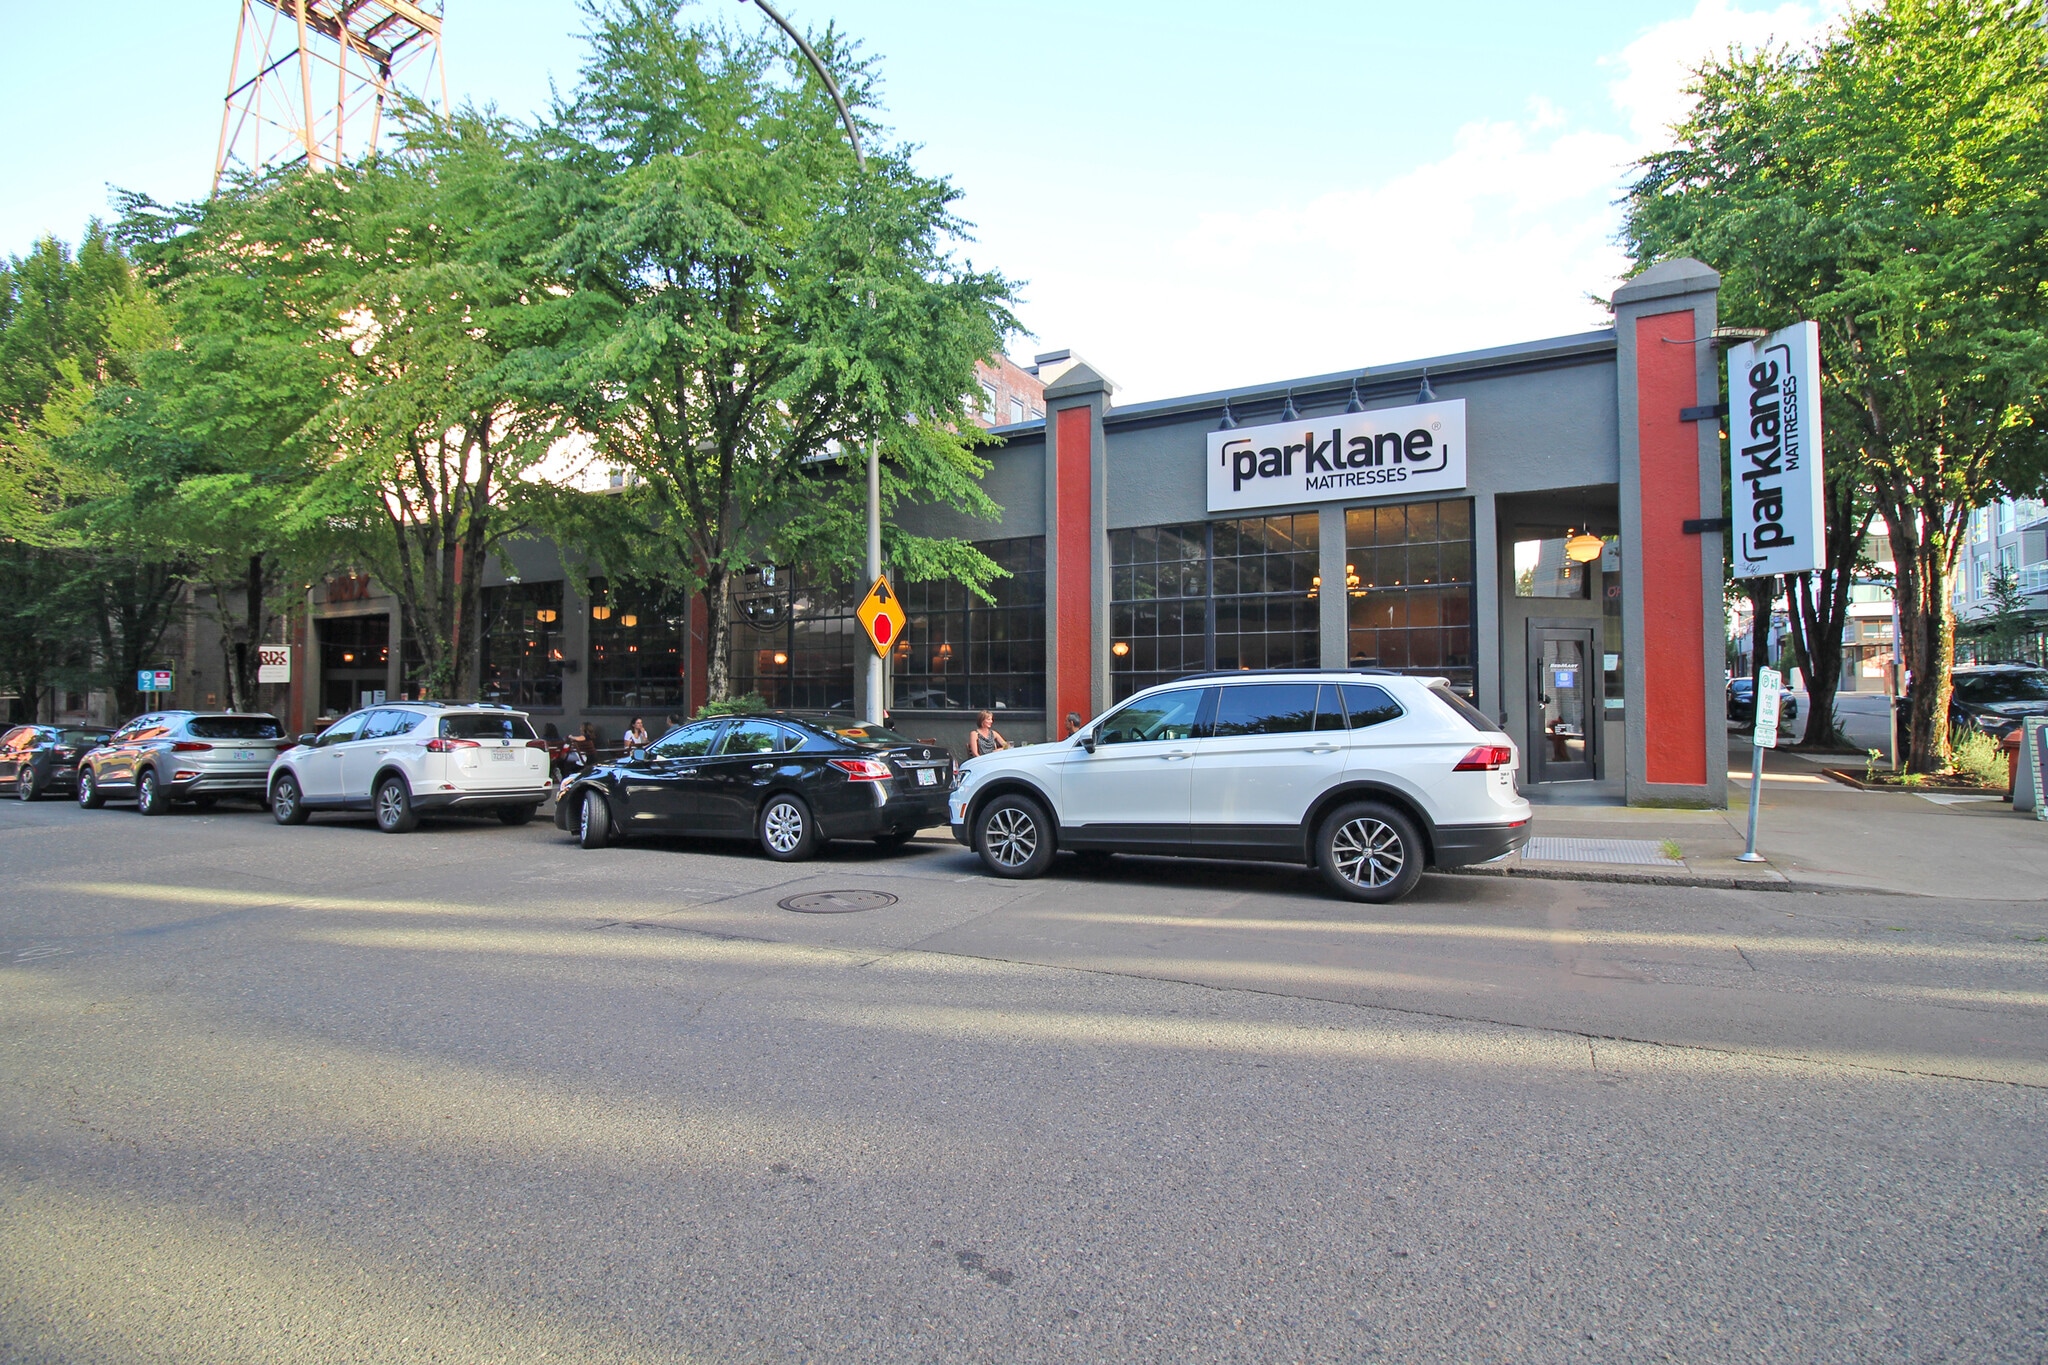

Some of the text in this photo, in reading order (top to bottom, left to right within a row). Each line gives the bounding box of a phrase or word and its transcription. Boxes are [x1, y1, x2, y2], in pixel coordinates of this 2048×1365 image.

[1741, 360, 1794, 549] parklane
[1783, 375, 1799, 471] MATTRESSES
[1233, 428, 1433, 491] parklane
[1306, 467, 1407, 491] MATTRESSES
[259, 651, 287, 663] RIX
